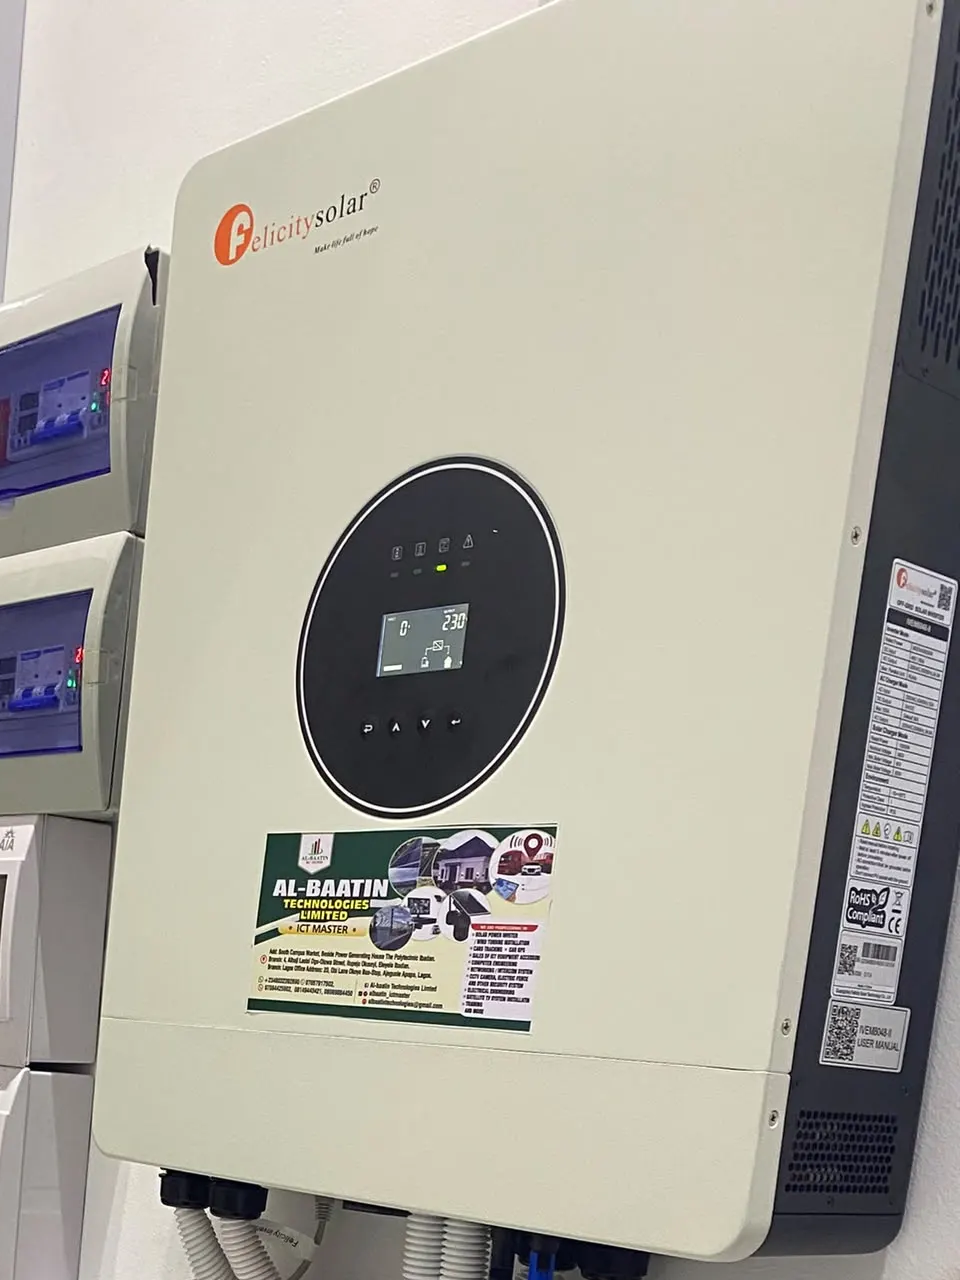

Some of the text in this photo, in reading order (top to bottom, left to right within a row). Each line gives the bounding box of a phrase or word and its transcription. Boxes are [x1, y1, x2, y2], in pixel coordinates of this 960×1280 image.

[442, 613, 465, 631] 230
[273, 879, 389, 897] AL-BAATIN
[850, 889, 871, 906] RoHS
[283, 899, 370, 910] TECHNOLOGIES
[300, 911, 348, 921] LIMITED
[297, 924, 349, 934] ICT MASTER
[857, 1039, 900, 1052] USER MANUAL
